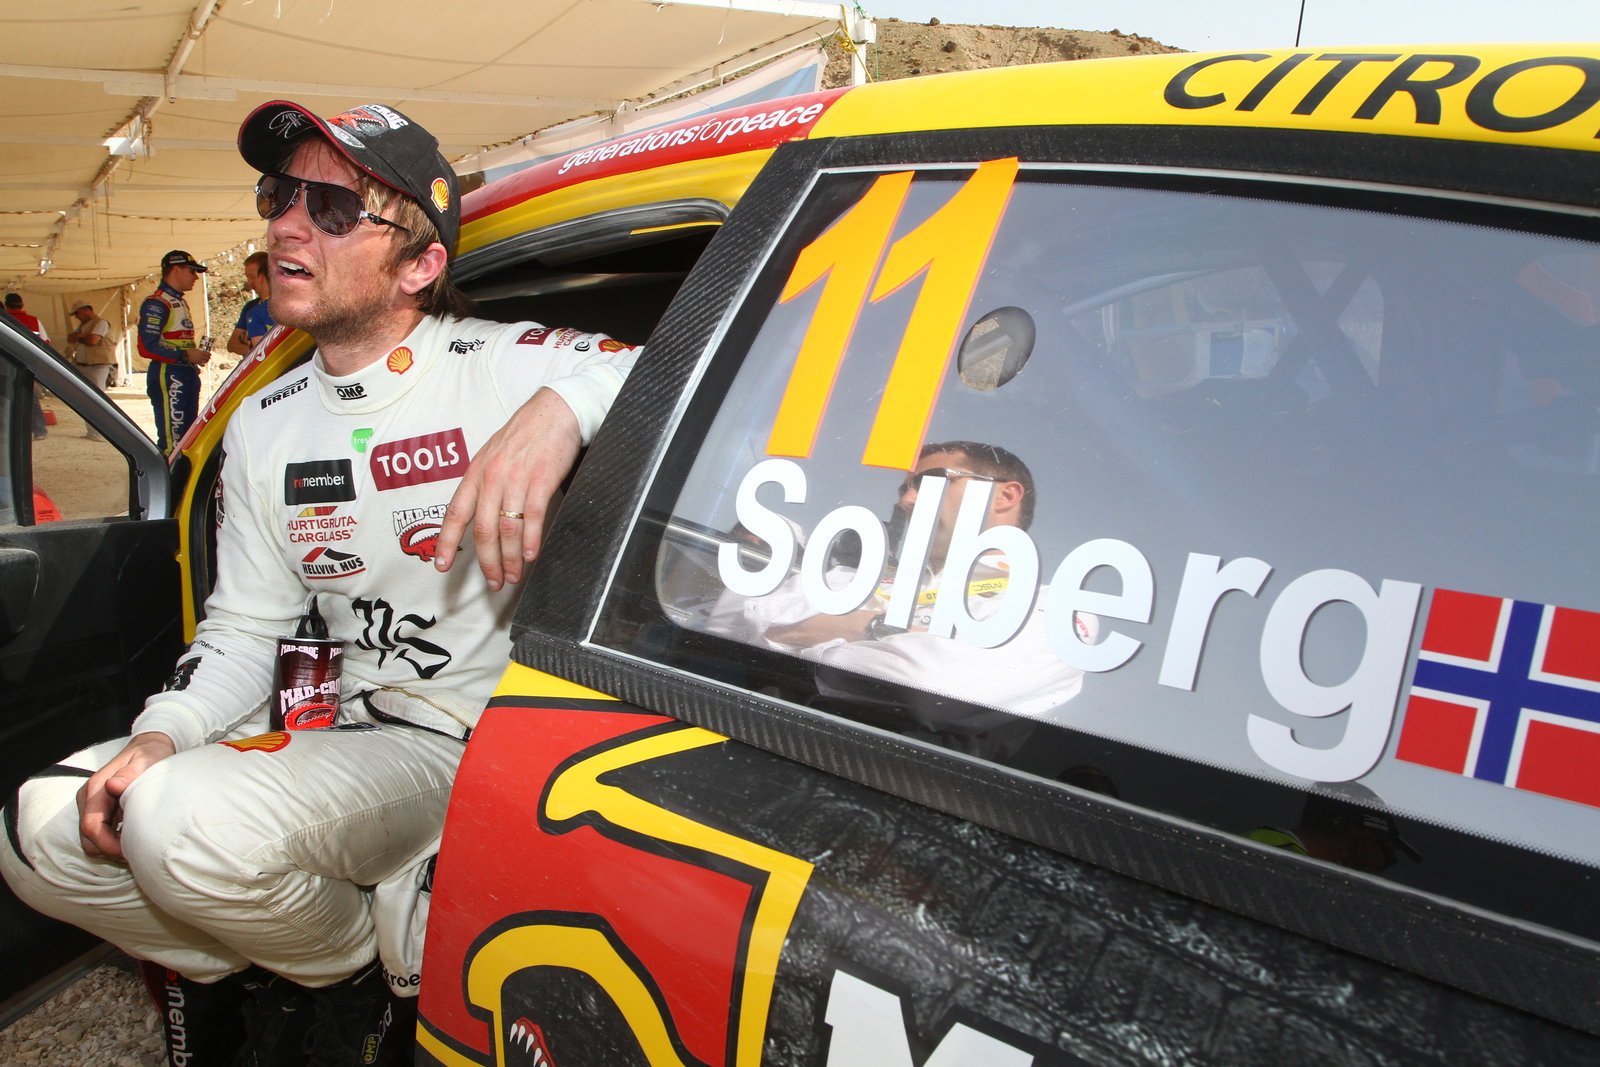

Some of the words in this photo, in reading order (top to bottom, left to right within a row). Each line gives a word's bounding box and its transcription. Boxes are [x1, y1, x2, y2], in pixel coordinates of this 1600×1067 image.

[1164, 53, 1600, 138] CITRO
[765, 156, 1019, 472] 11
[261, 376, 309, 410] PIRELLI
[335, 383, 367, 400] OMP
[377, 442, 460, 477] TOOLS
[392, 503, 449, 536] MAD-CR
[302, 563, 338, 574] HELLVIK
[339, 557, 364, 572] HUS
[718, 459, 1423, 783] Solberg
[280, 644, 319, 660] MAD-CROC
